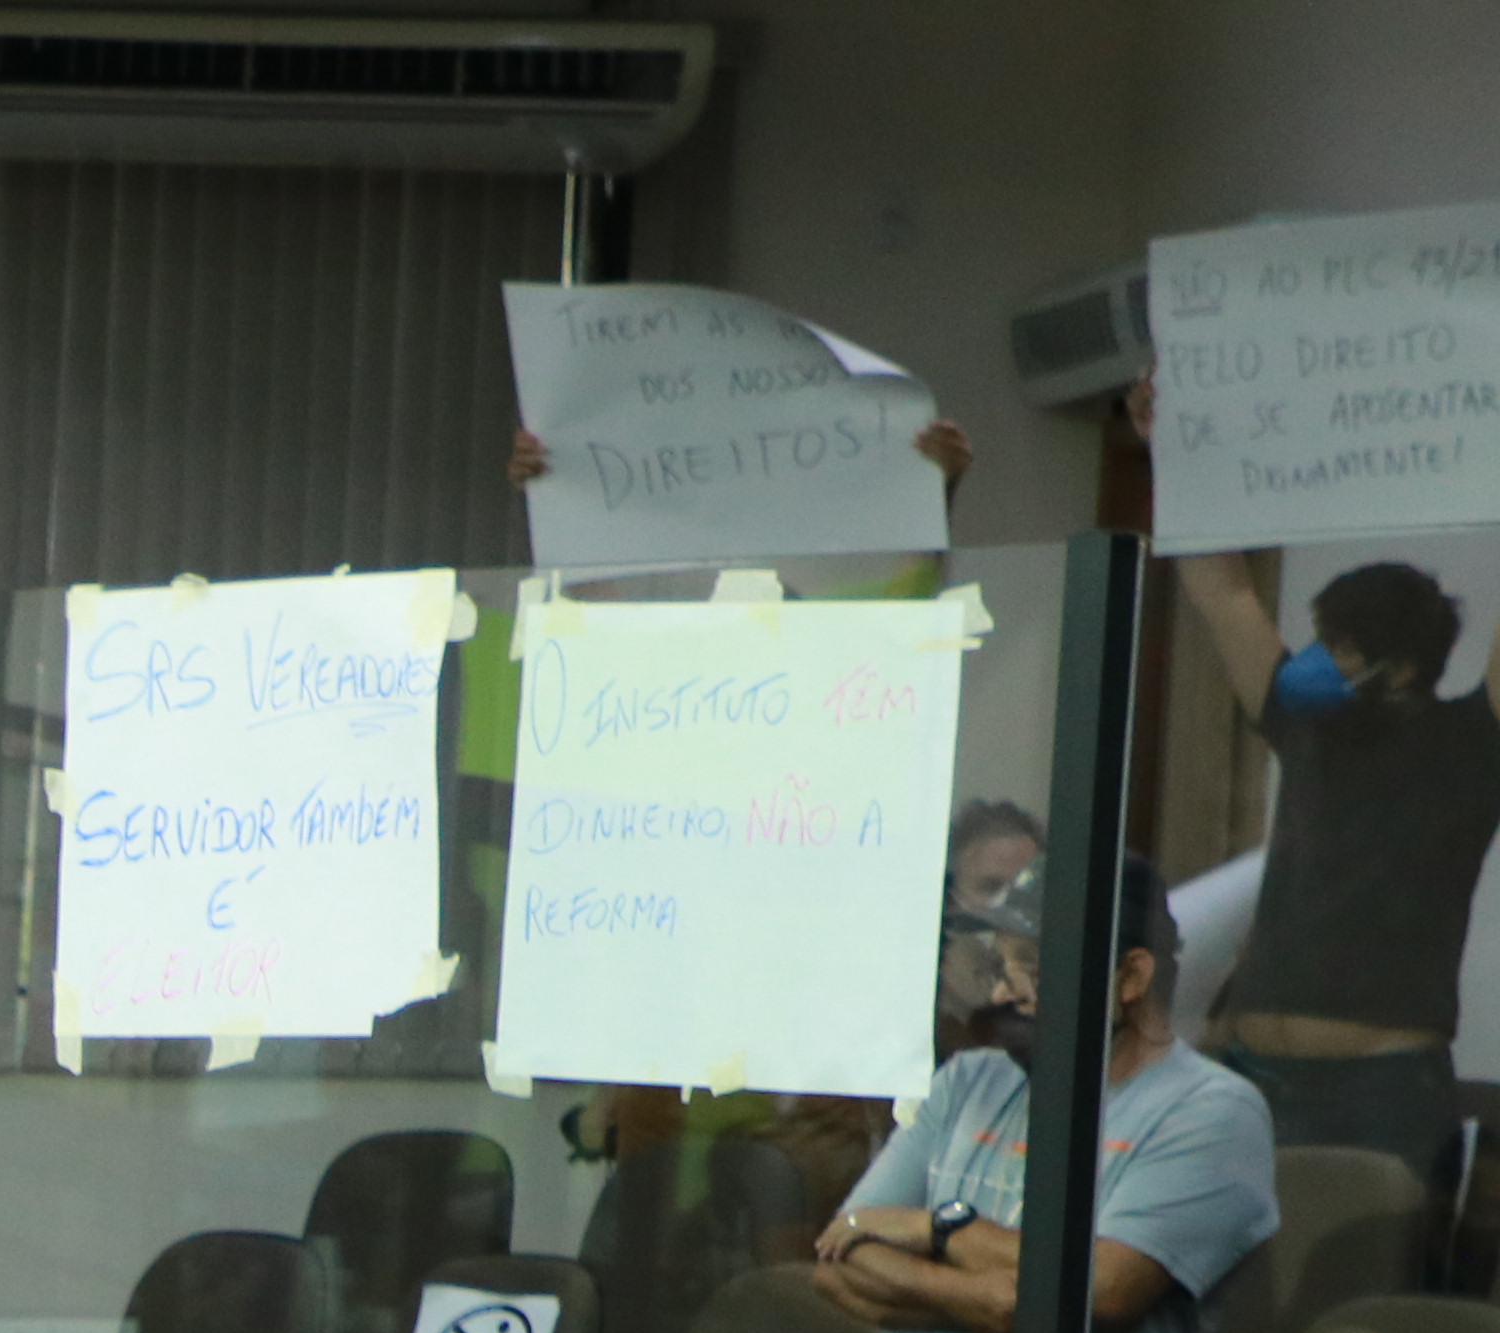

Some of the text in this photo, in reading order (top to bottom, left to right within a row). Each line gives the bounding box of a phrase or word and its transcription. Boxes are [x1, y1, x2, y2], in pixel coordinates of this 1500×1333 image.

[1168, 322, 1457, 388] PELO DIREITO
[84, 620, 217, 722] SRS
[581, 671, 790, 749] INSTITUTO
[744, 771, 839, 848] NÃO
[523, 883, 679, 943] REFORMA
